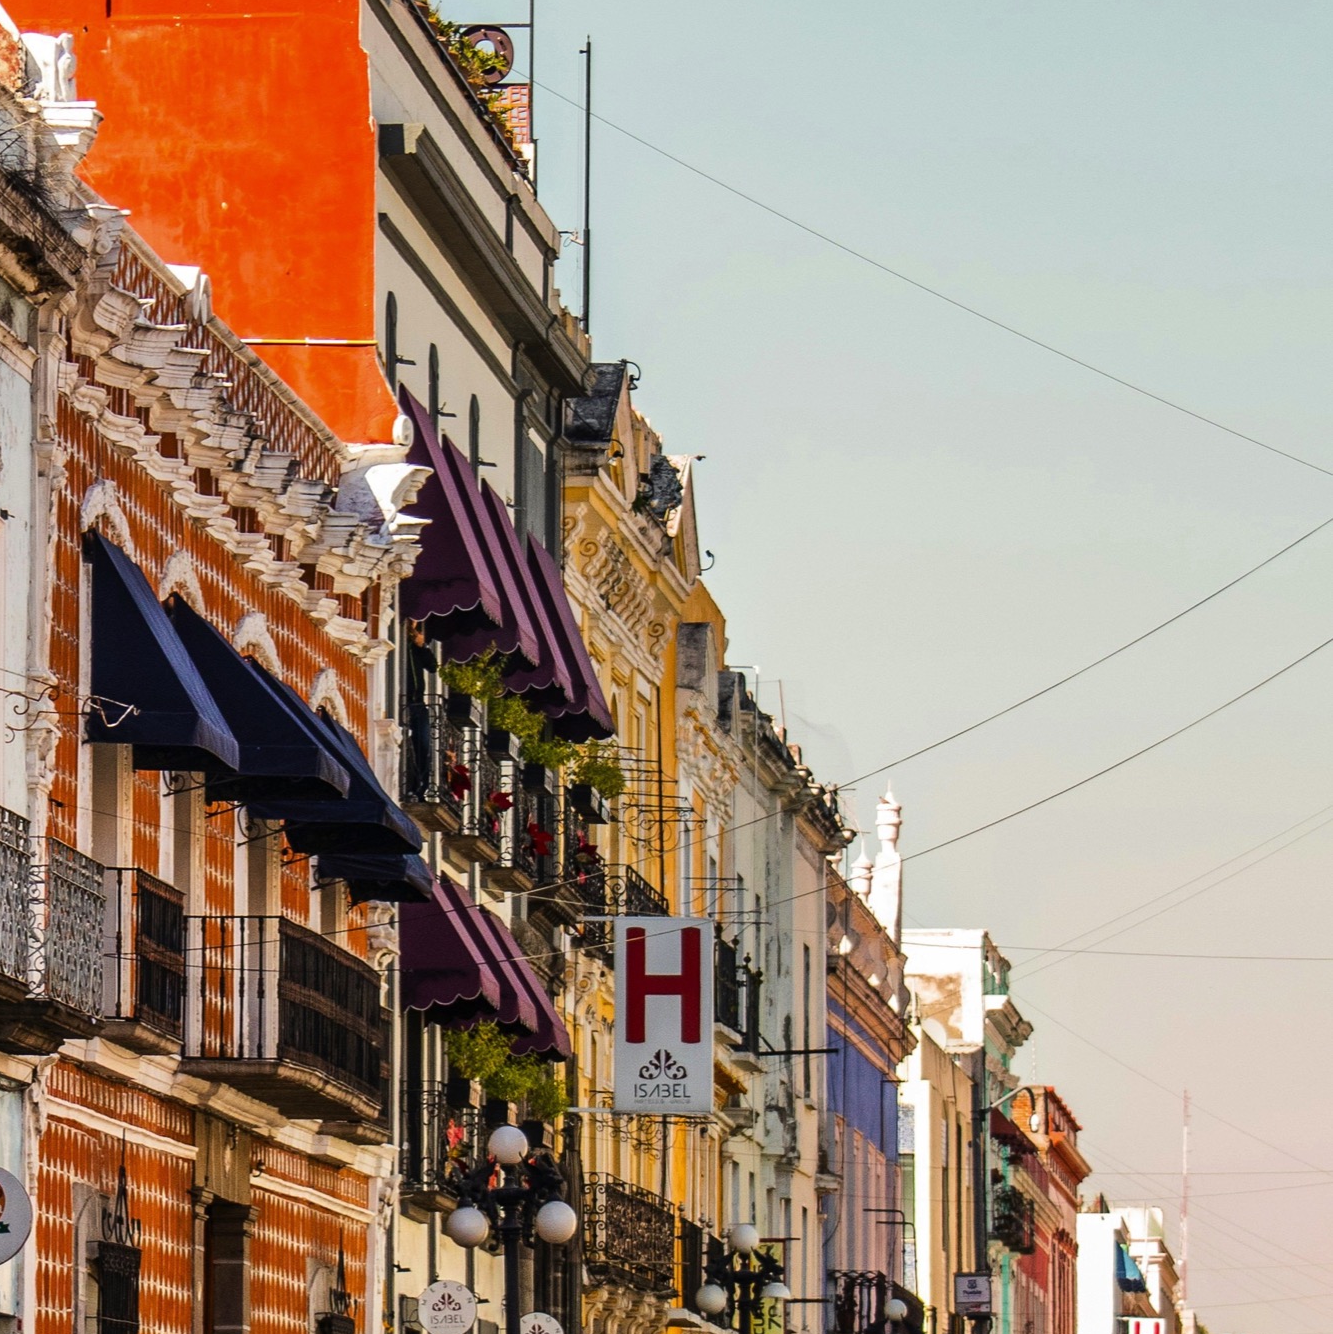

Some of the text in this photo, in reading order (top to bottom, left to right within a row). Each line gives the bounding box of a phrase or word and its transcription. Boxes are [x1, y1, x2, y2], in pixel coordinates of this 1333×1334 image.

[625, 927, 701, 1044] H
[634, 1083, 691, 1098] ISABEL
[430, 1314, 465, 1325] ISABEL
